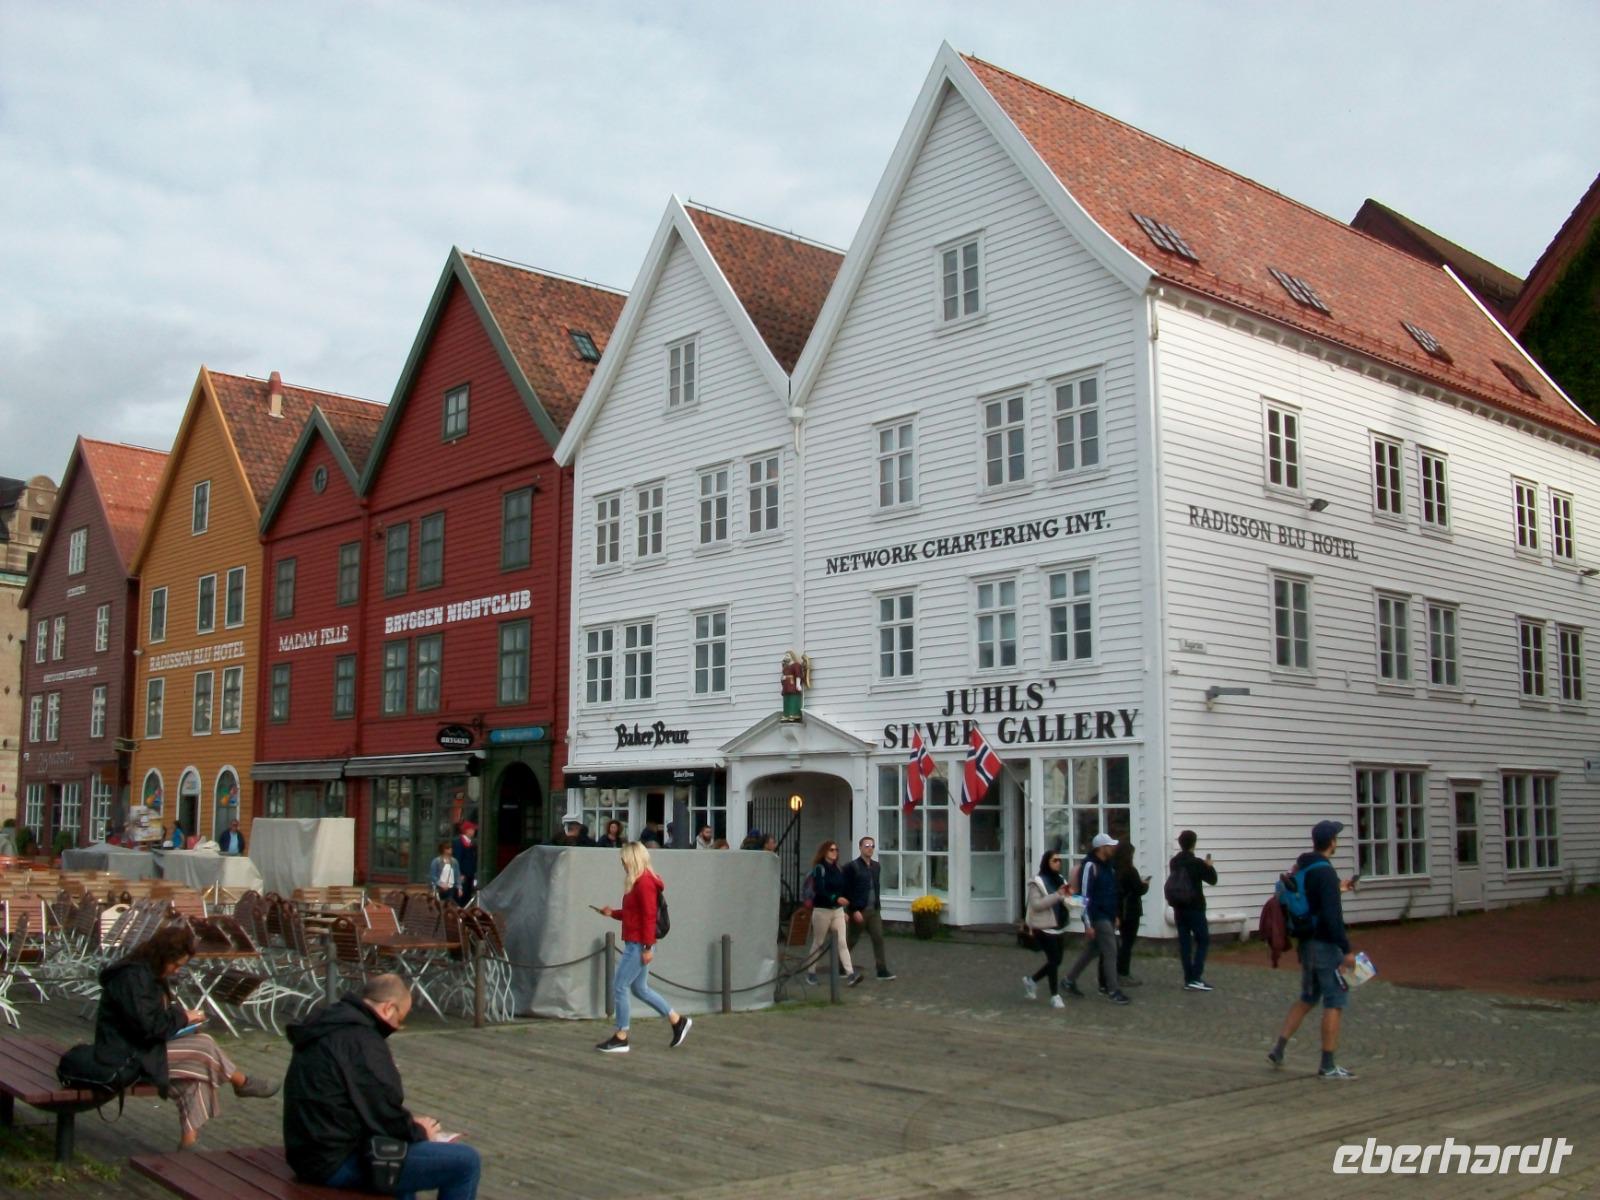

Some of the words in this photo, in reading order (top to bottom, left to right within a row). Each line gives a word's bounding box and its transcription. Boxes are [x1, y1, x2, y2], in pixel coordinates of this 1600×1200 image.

[826, 543, 918, 575] NETWORK
[923, 518, 1059, 559] CHARTERING
[1065, 509, 1112, 536] INT.
[1188, 505, 1271, 542] RADISSON
[1278, 526, 1305, 549] BLU
[1312, 532, 1359, 560] HOTEL
[385, 606, 444, 634] BRYGGEN
[446, 589, 532, 623] NIGHTCLUB
[149, 650, 192, 672] RADISSON
[194, 646, 211, 664] BLU
[213, 641, 246, 662] HOTEL
[278, 630, 318, 652] MADAM
[320, 625, 349, 646] FELLE
[614, 723, 654, 751] Baker
[652, 720, 690, 749] Brun
[997, 708, 1139, 744] GALLERY
